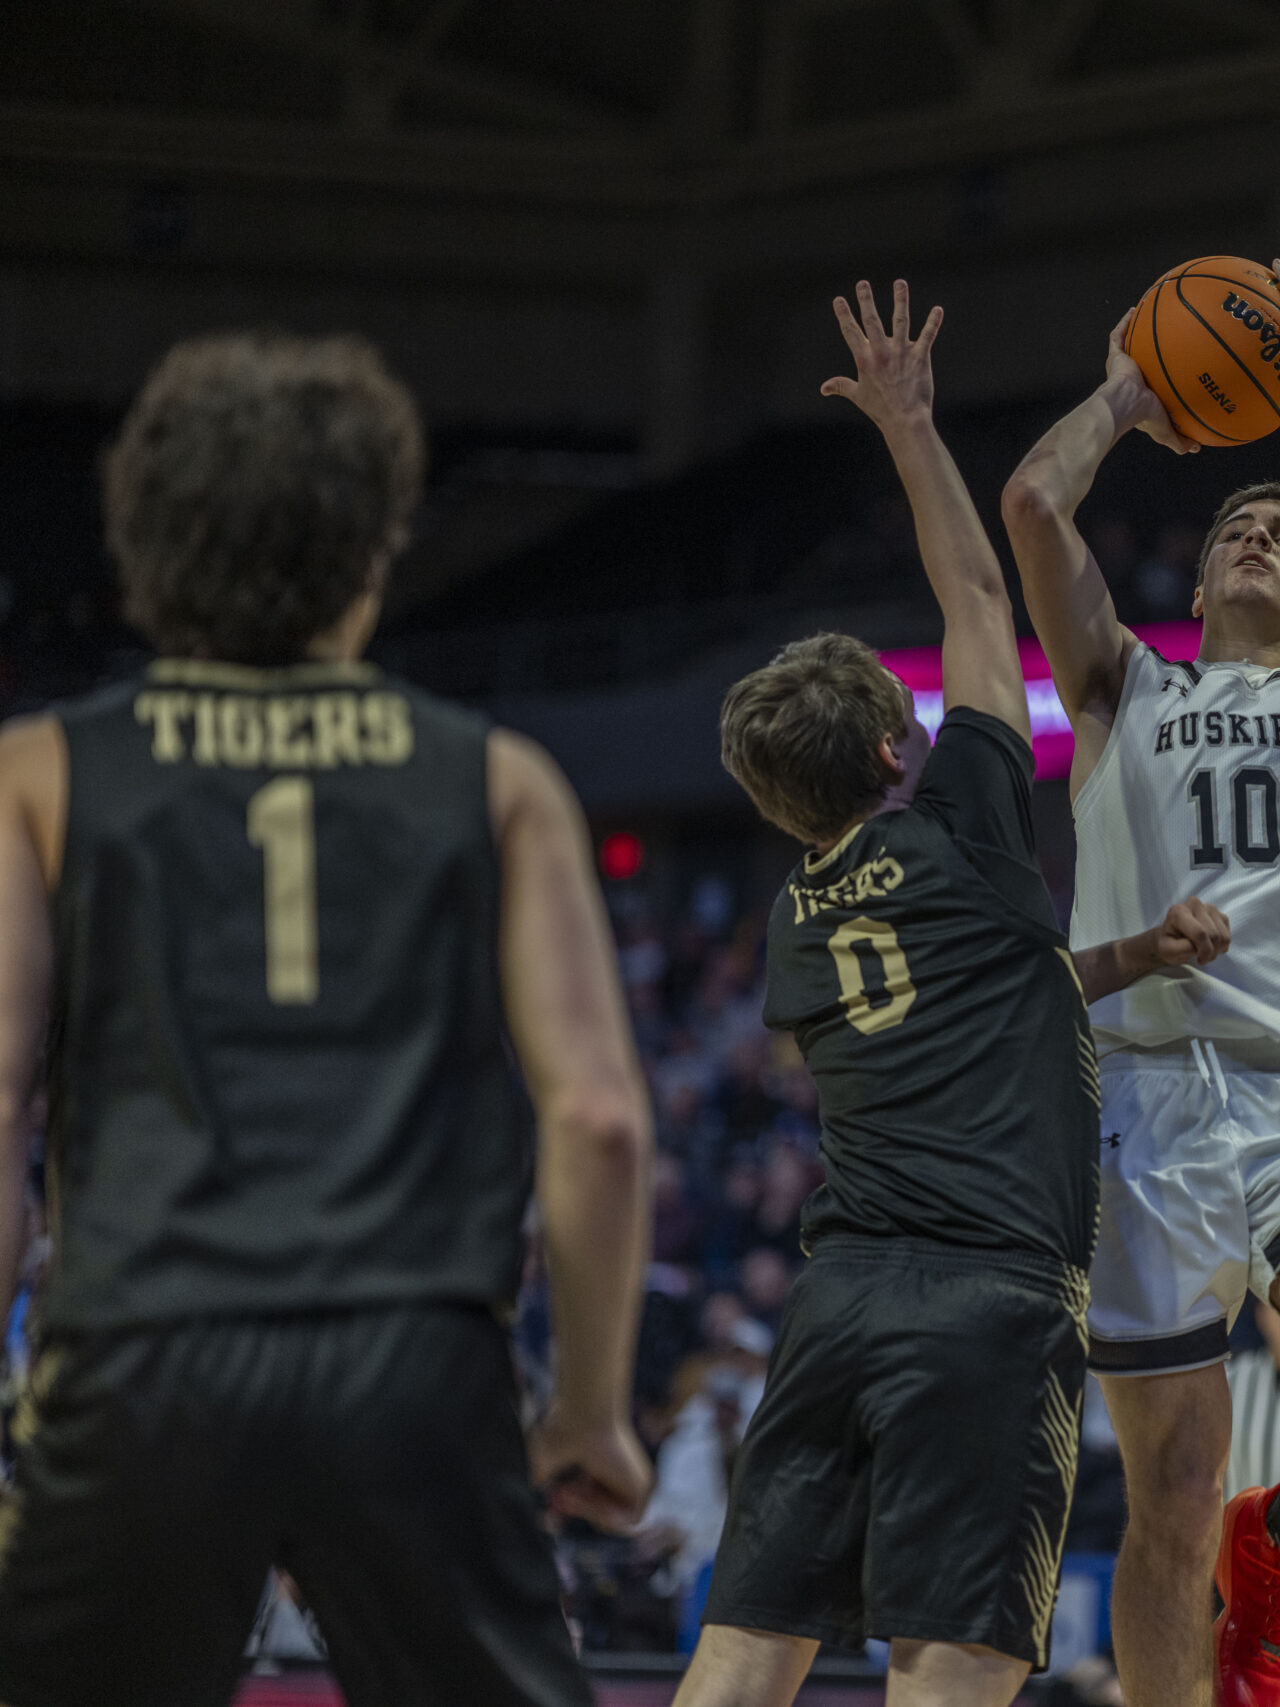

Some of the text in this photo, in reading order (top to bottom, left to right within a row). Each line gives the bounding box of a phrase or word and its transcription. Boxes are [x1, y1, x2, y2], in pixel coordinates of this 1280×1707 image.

[1198, 372, 1232, 409] NFHS
[135, 692, 413, 769] TIGERS
[247, 776, 318, 1005] 1
[827, 915, 917, 1035] 0
